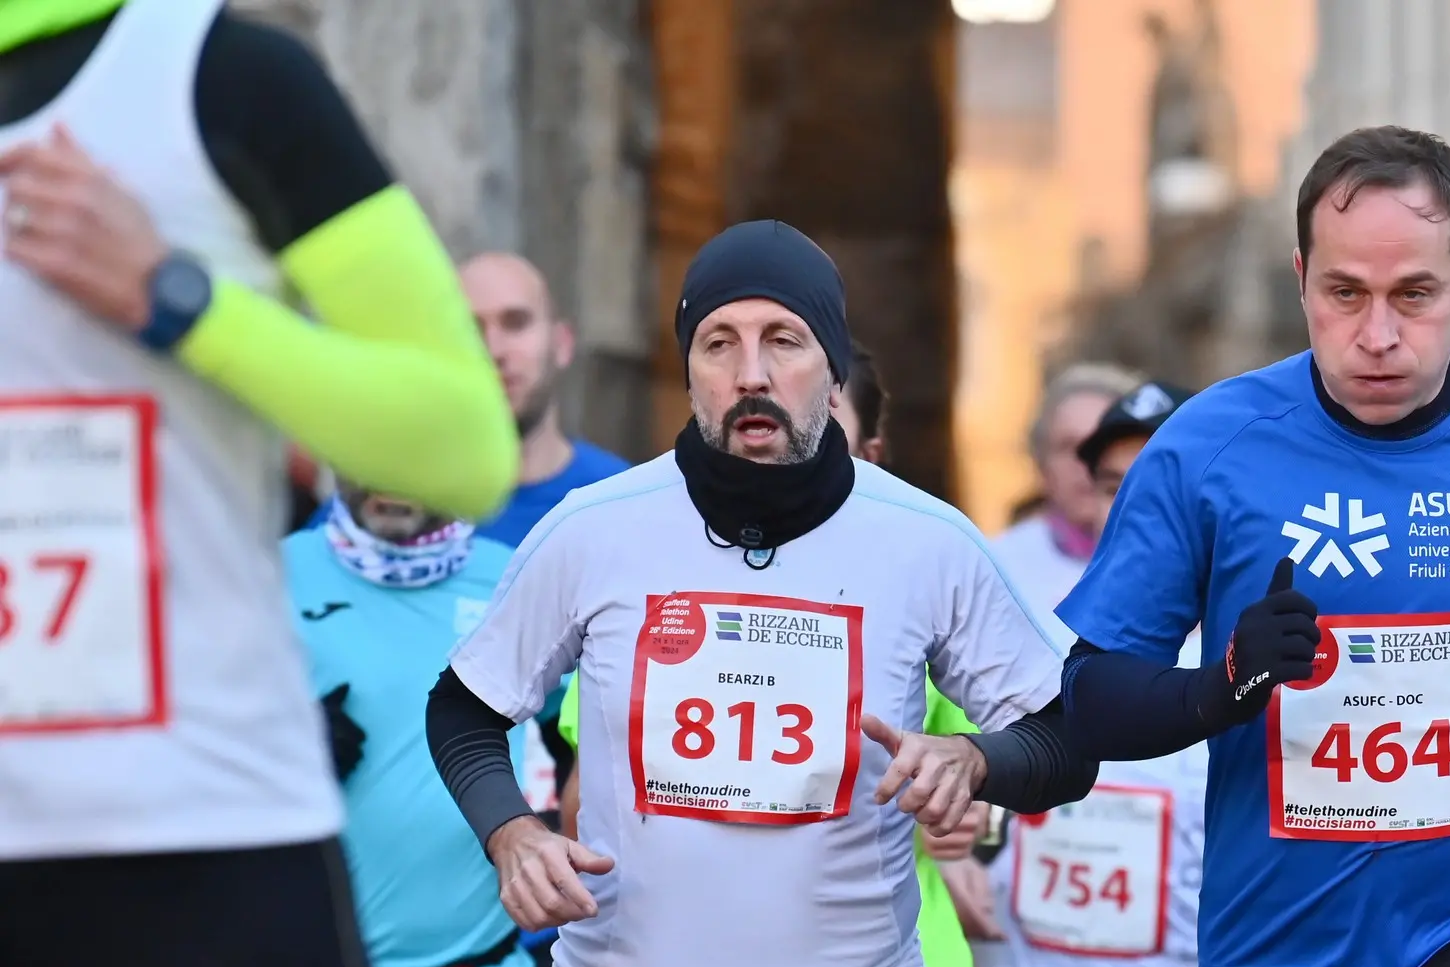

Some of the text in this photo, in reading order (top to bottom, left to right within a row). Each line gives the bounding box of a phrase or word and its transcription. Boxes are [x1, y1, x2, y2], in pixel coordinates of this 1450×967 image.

[1409, 563, 1446, 578] Friuli
[662, 617, 684, 625] Udine
[748, 613, 820, 632] RIZZANI
[747, 629, 844, 650] DE ECCHER
[1381, 649, 1405, 663] DE
[718, 672, 775, 687] BEARZI B
[1343, 695, 1386, 707] ASUFC
[1396, 693, 1423, 705] DOC
[671, 698, 815, 765] 813
[646, 779, 751, 797] #telethonudine
[648, 791, 729, 809] #noicisiamo
[1284, 803, 1397, 817] #telethonudine
[1284, 815, 1376, 829] #noicisiamo
[1038, 855, 1131, 913] 754
